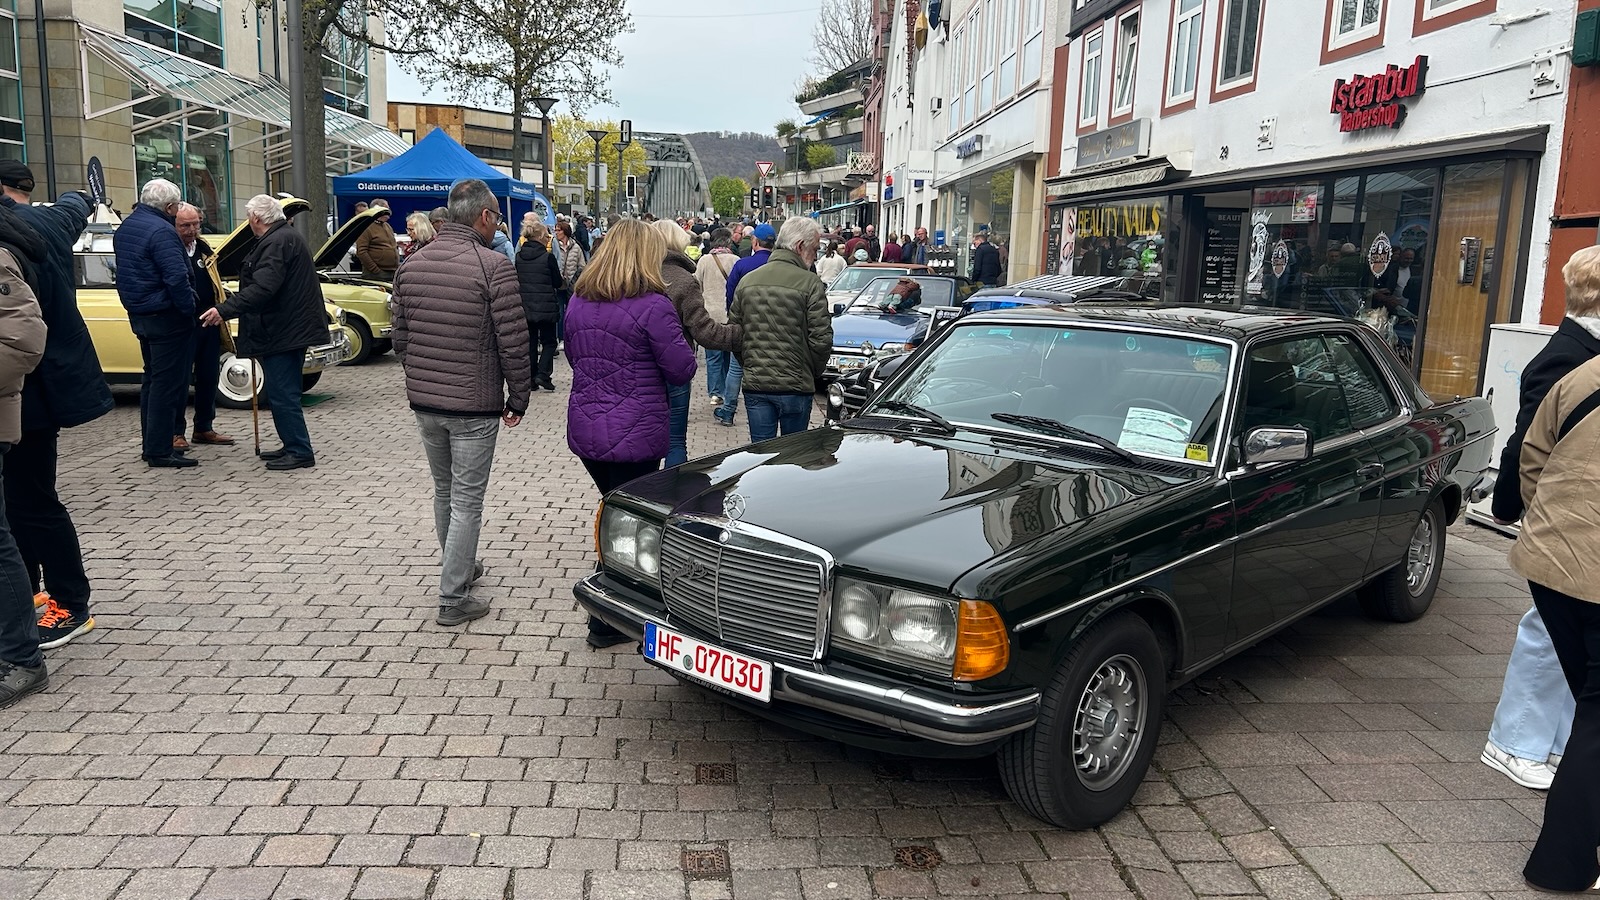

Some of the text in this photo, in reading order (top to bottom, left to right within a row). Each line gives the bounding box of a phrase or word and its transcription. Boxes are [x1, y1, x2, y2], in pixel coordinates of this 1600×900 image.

[1330, 55, 1424, 114] Istanbul
[1077, 202, 1161, 239] BEAUTY NAILS
[1217, 214, 1241, 222] BEAUT
[1187, 443, 1207, 452] ADAC
[648, 643, 654, 652] D
[658, 630, 763, 693] HF 07030
